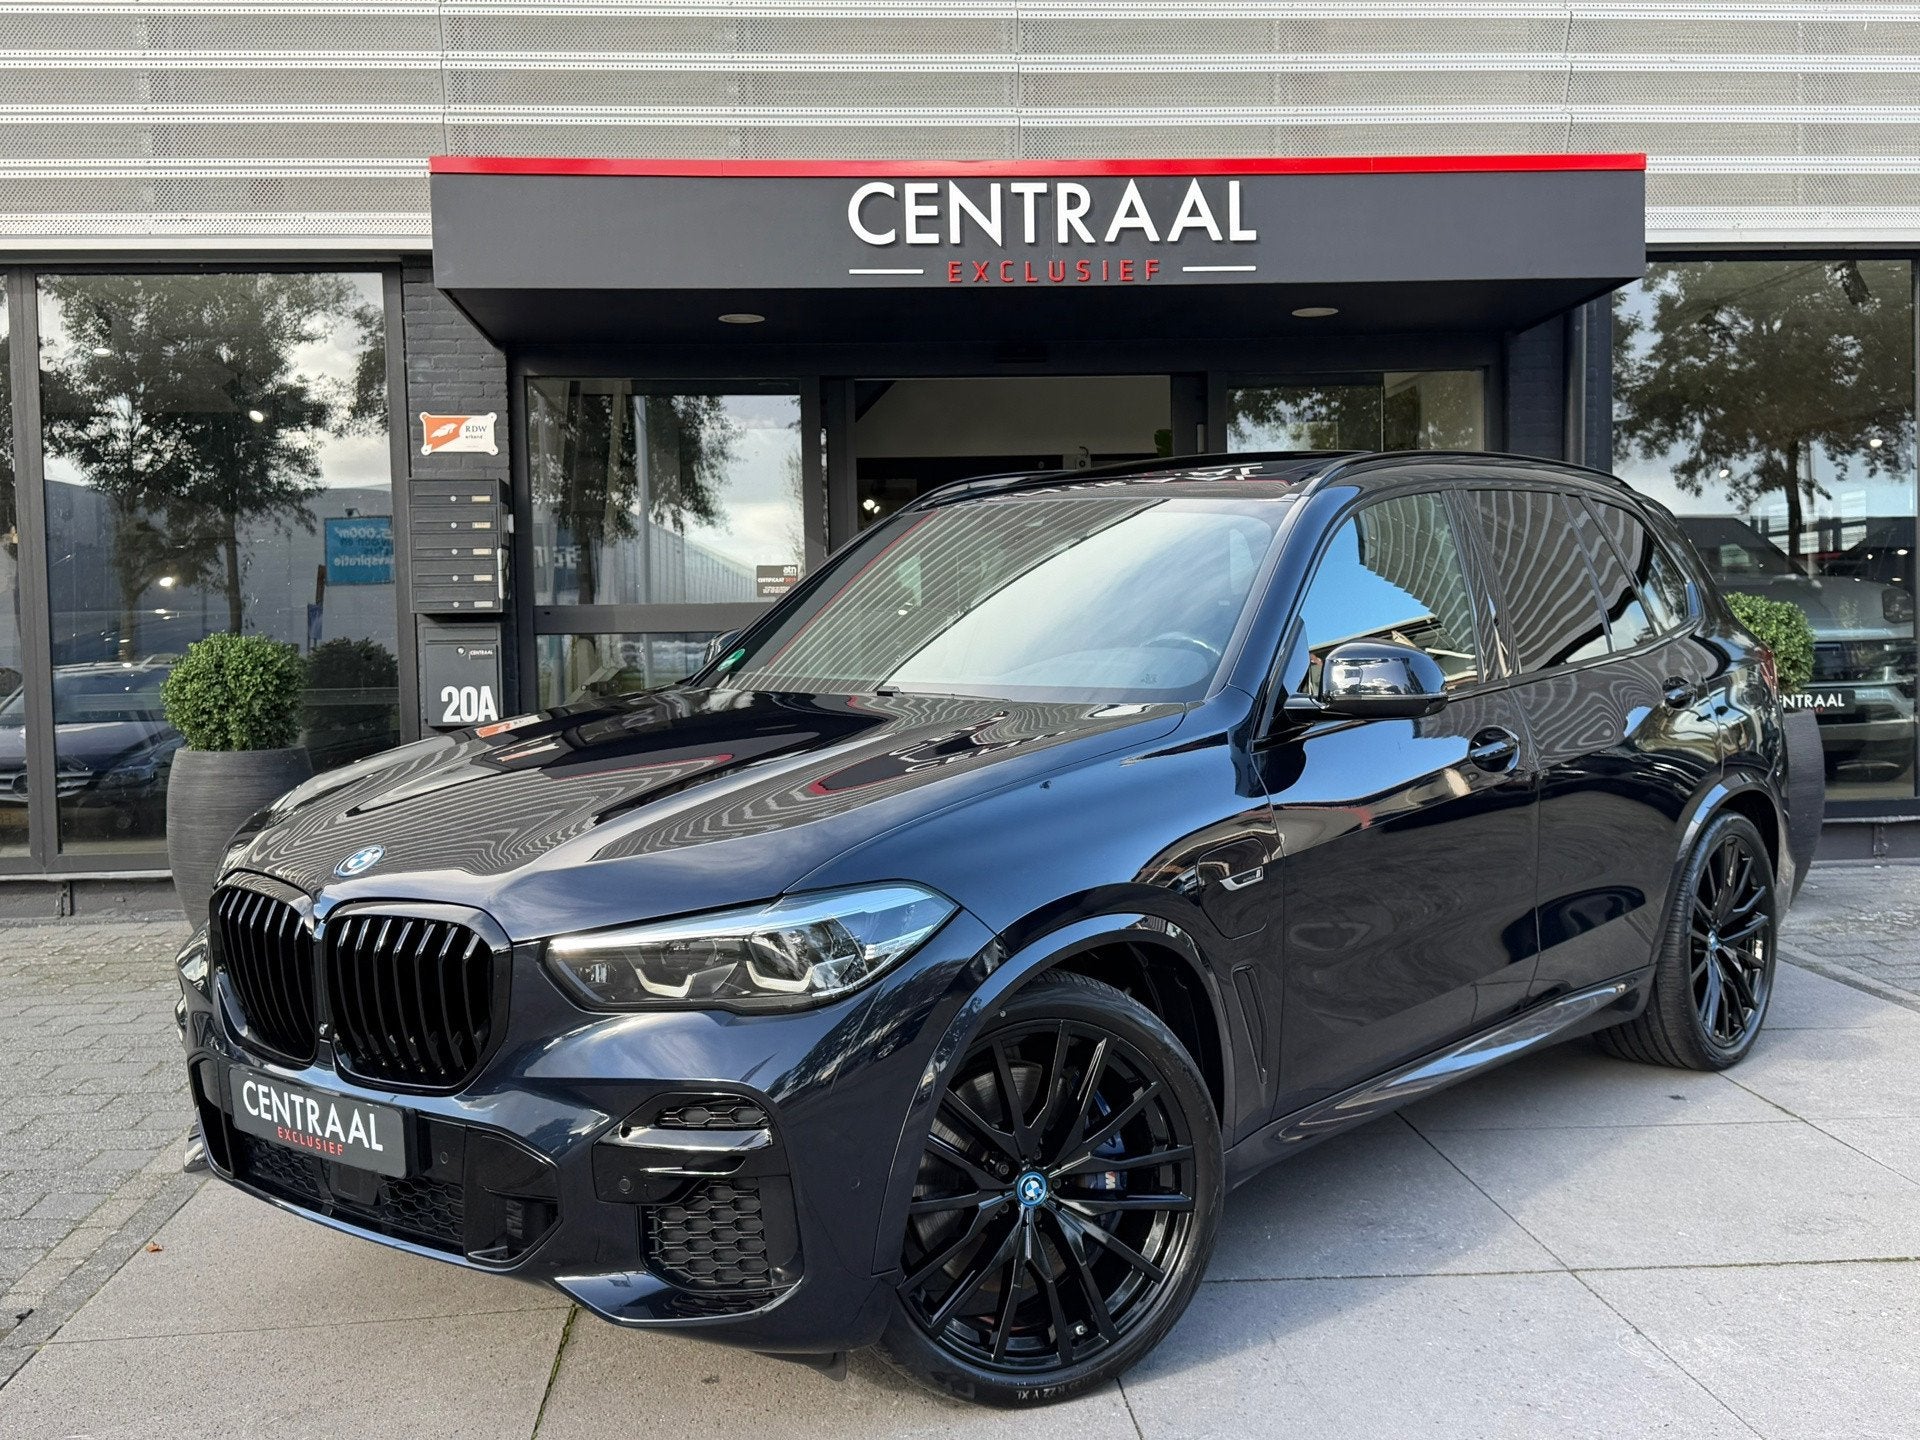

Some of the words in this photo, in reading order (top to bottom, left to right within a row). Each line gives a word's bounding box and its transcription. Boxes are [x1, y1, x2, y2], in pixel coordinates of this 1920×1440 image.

[848, 178, 1257, 246] CENTRAAL
[948, 259, 1160, 283] EXCLUSIEF
[465, 425, 487, 433] RDW
[441, 686, 498, 722] 20A
[1779, 693, 1845, 708] NTRAAL
[242, 1080, 383, 1152] CENTRAAL
[277, 1126, 343, 1156] EXCLUSIEF
